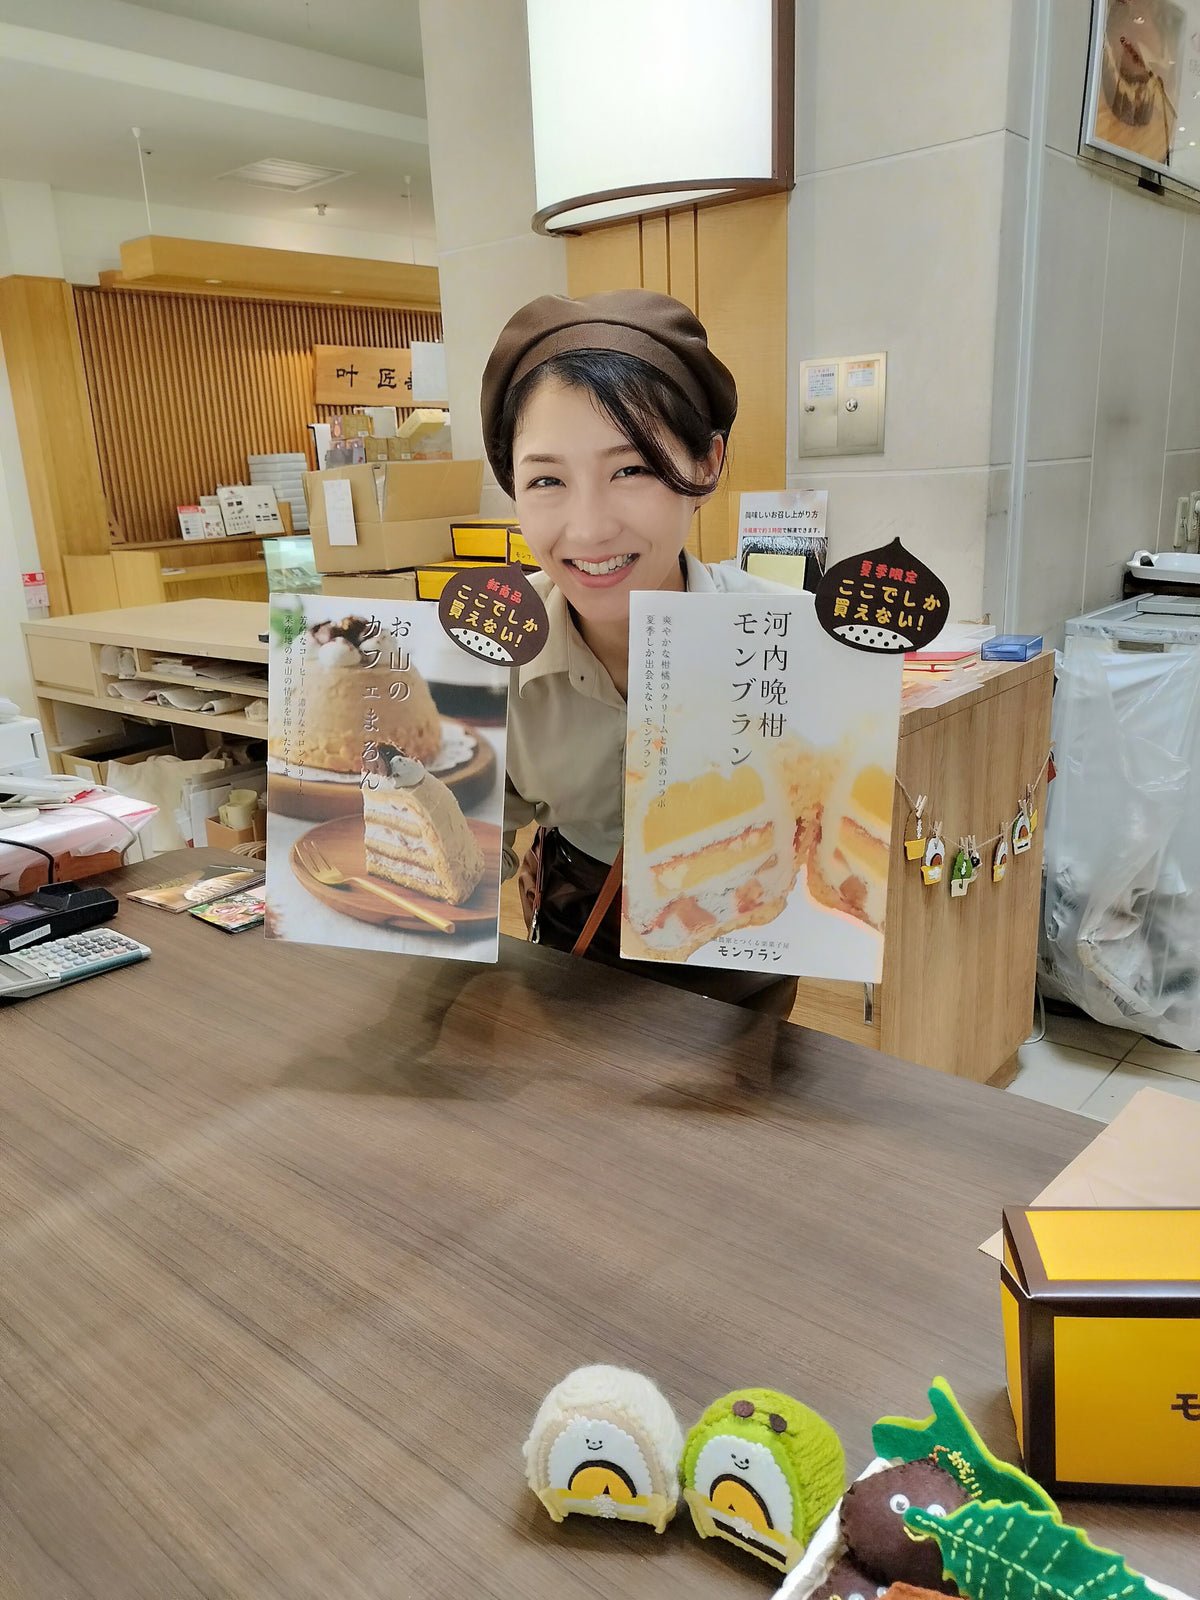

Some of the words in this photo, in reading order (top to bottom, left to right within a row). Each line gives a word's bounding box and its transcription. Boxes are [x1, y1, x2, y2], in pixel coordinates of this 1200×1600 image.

[744, 510, 819, 519] 美味しいお召し上がり方
[486, 578, 522, 604] 新商品
[839, 579, 941, 611] ここでしか
[860, 560, 918, 585] 夏季限定
[448, 599, 523, 648] 買えない!
[457, 584, 538, 633] ここでしか
[833, 597, 924, 631] 買えない!
[389, 616, 412, 702] お山の
[758, 611, 792, 738] 河内晩柑
[359, 614, 383, 791] カフェまろん
[658, 615, 672, 808] 爽やかな柑橘のクリームと和栗のコラボ
[731, 612, 758, 766] モンブラン
[718, 945, 782, 961] モンブラン
